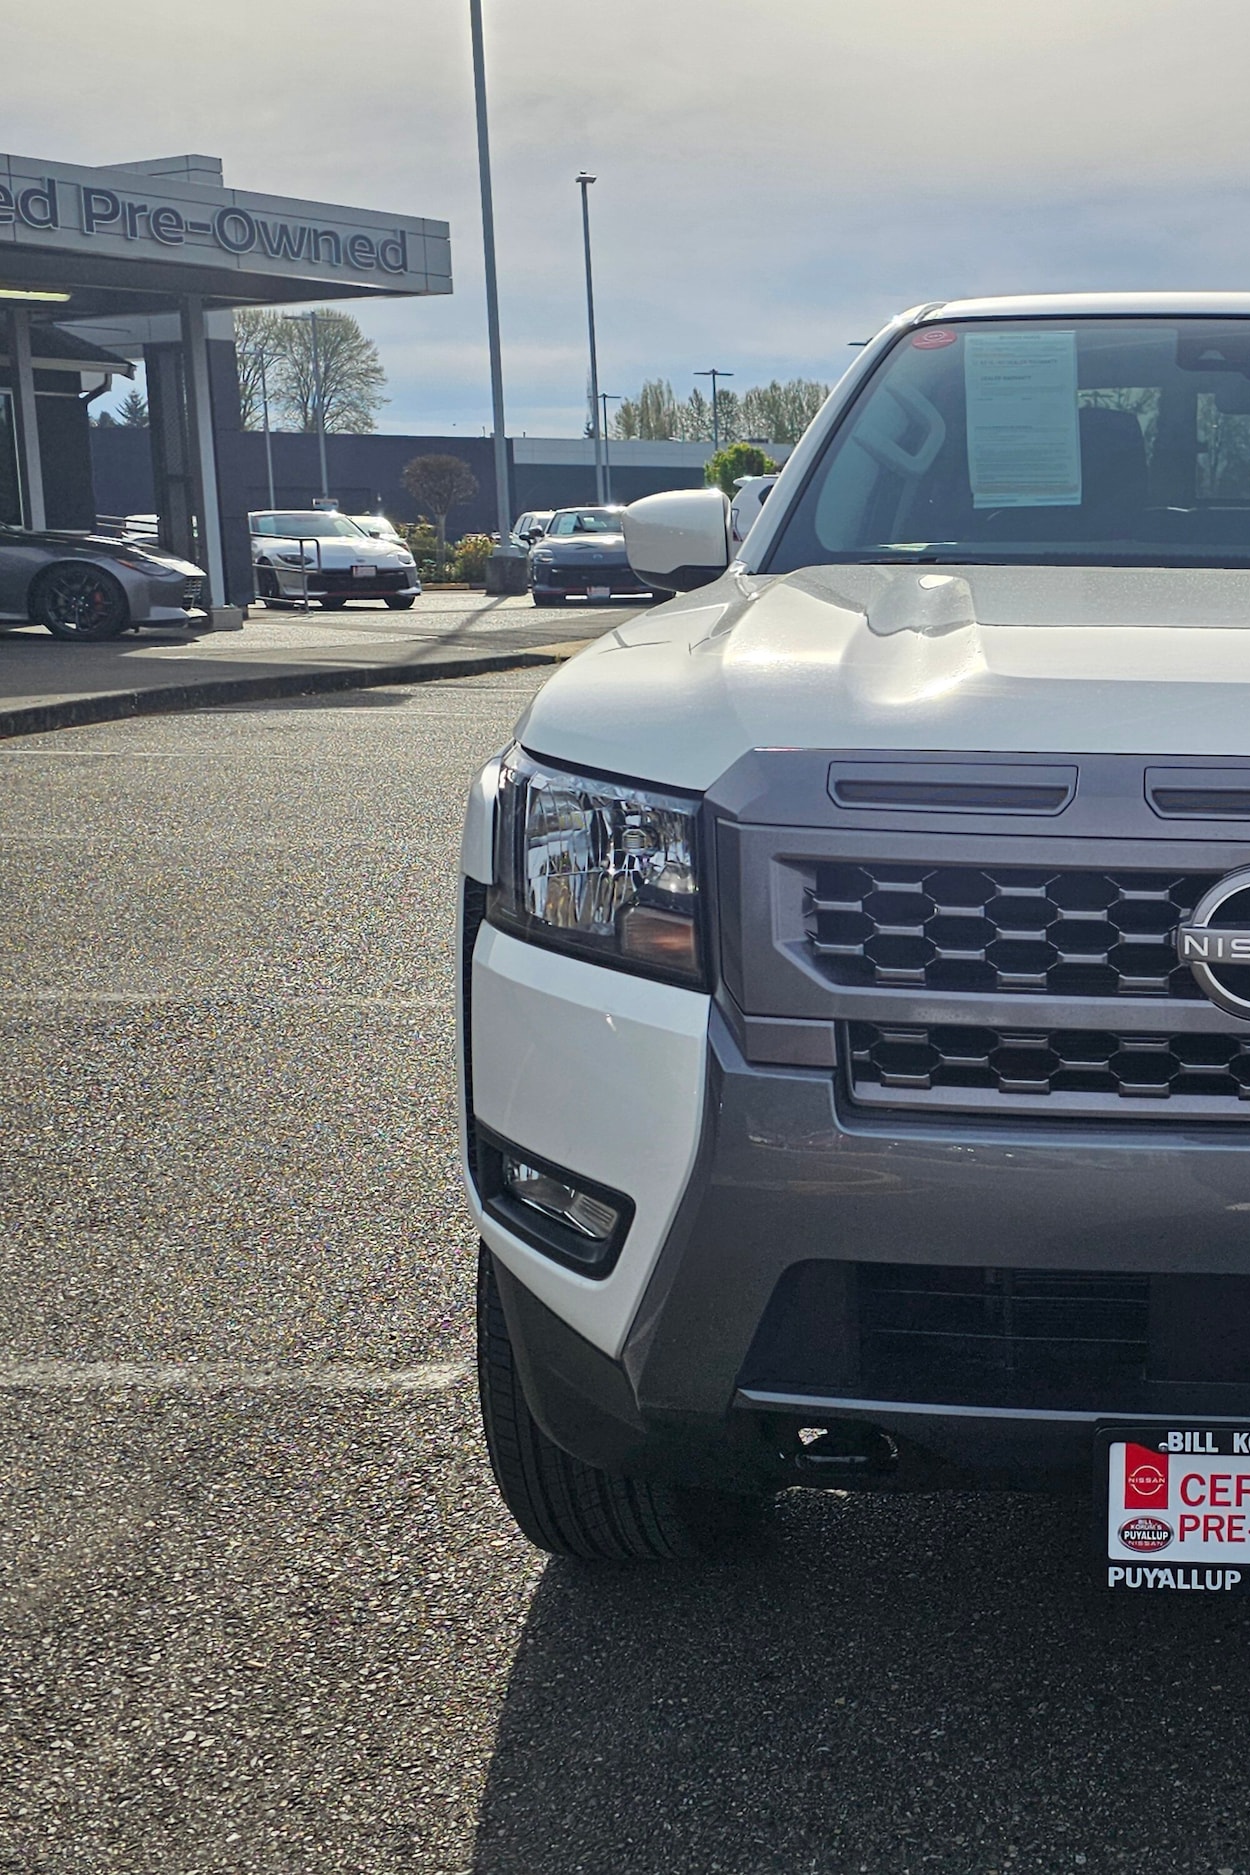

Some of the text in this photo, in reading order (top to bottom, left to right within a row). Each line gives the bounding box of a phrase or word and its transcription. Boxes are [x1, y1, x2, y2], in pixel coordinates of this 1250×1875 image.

[80, 185, 408, 274] Pre-Owned
[1168, 1431, 1219, 1453] BILL
[1124, 1531, 1169, 1540] PUYALLUP
[1107, 1566, 1242, 1591] PUYALLUP
